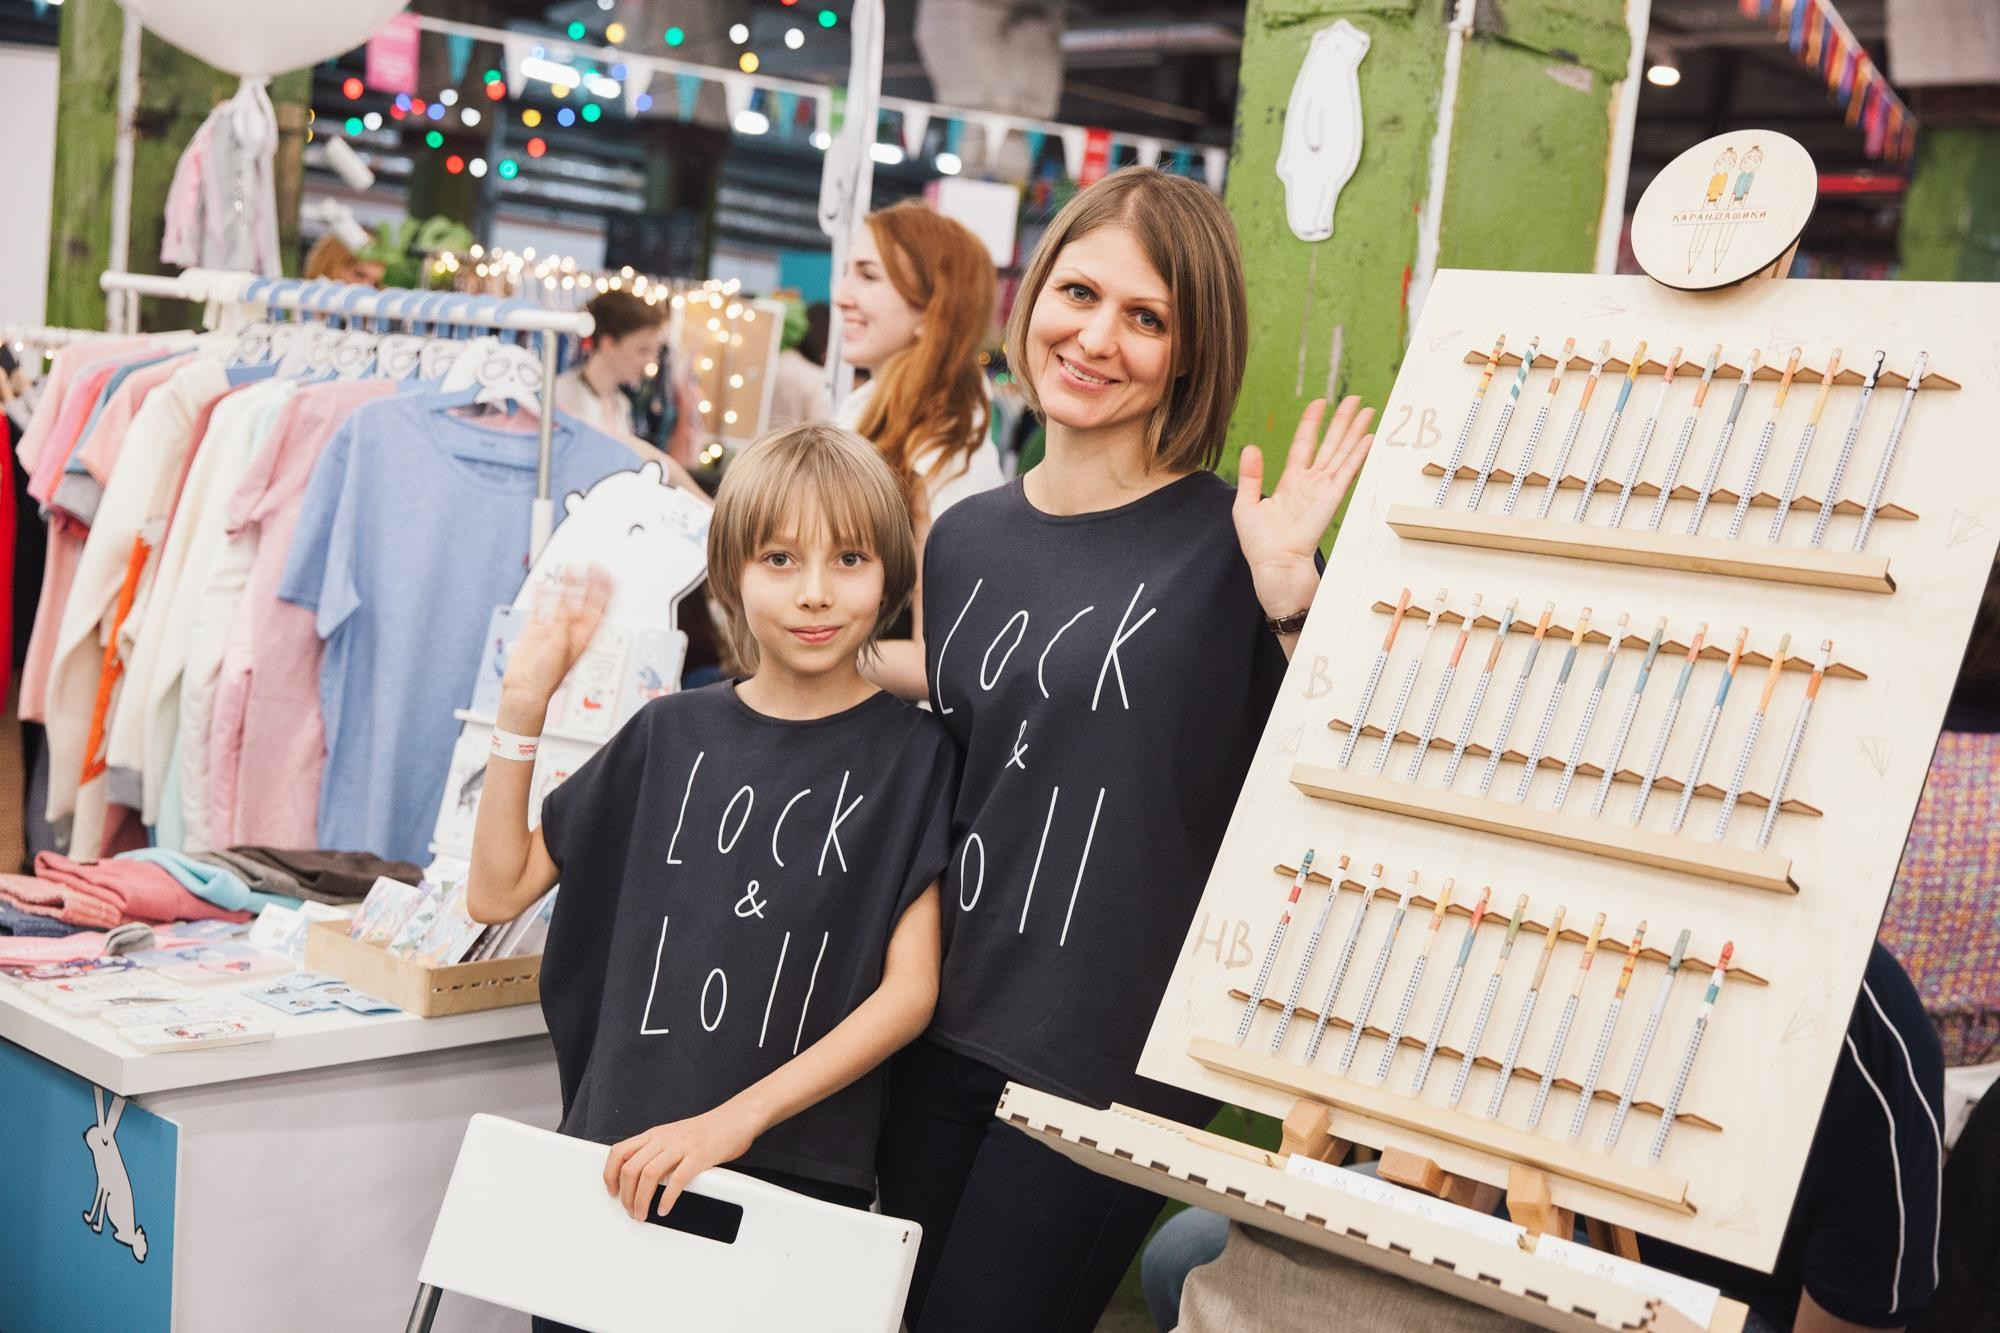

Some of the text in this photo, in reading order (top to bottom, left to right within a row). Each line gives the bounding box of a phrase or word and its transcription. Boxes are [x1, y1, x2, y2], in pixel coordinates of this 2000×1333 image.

[1672, 210, 1767, 223] КАРАНДАШИКИ
[1386, 404, 1441, 448] 2B
[1302, 656, 1333, 700] B
[1005, 720, 1029, 769] &
[667, 752, 863, 876] LOCK
[960, 786, 1105, 946] oll
[734, 879, 768, 919] &
[1192, 912, 1253, 969] HB
